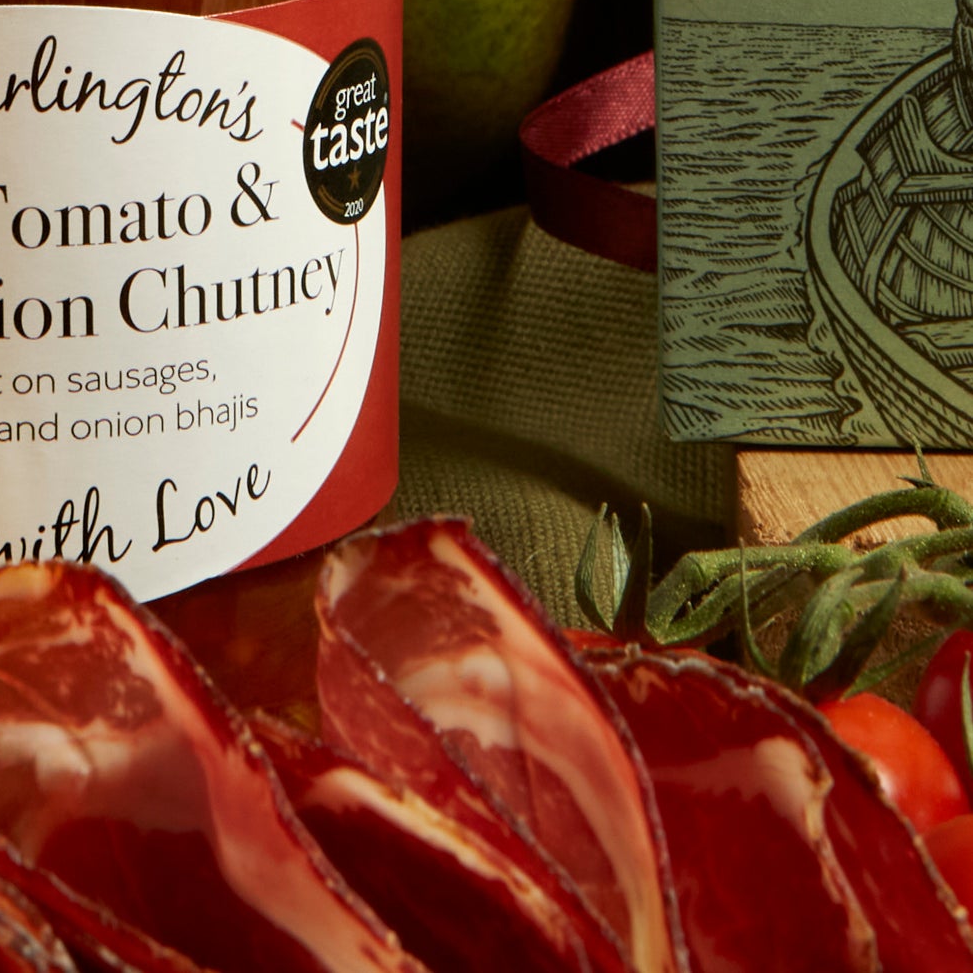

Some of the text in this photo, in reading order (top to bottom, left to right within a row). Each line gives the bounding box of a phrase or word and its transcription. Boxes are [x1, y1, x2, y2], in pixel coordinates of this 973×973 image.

[334, 72, 377, 121] great
[310, 106, 389, 171] taste
[230, 161, 280, 228] &
[343, 198, 364, 218] 2020
[119, 247, 346, 334] Chutney
[12, 372, 56, 394] on
[67, 358, 217, 395] sausages,
[70, 401, 165, 436] onion
[176, 393, 259, 432] bhajis
[151, 463, 271, 553] Love
